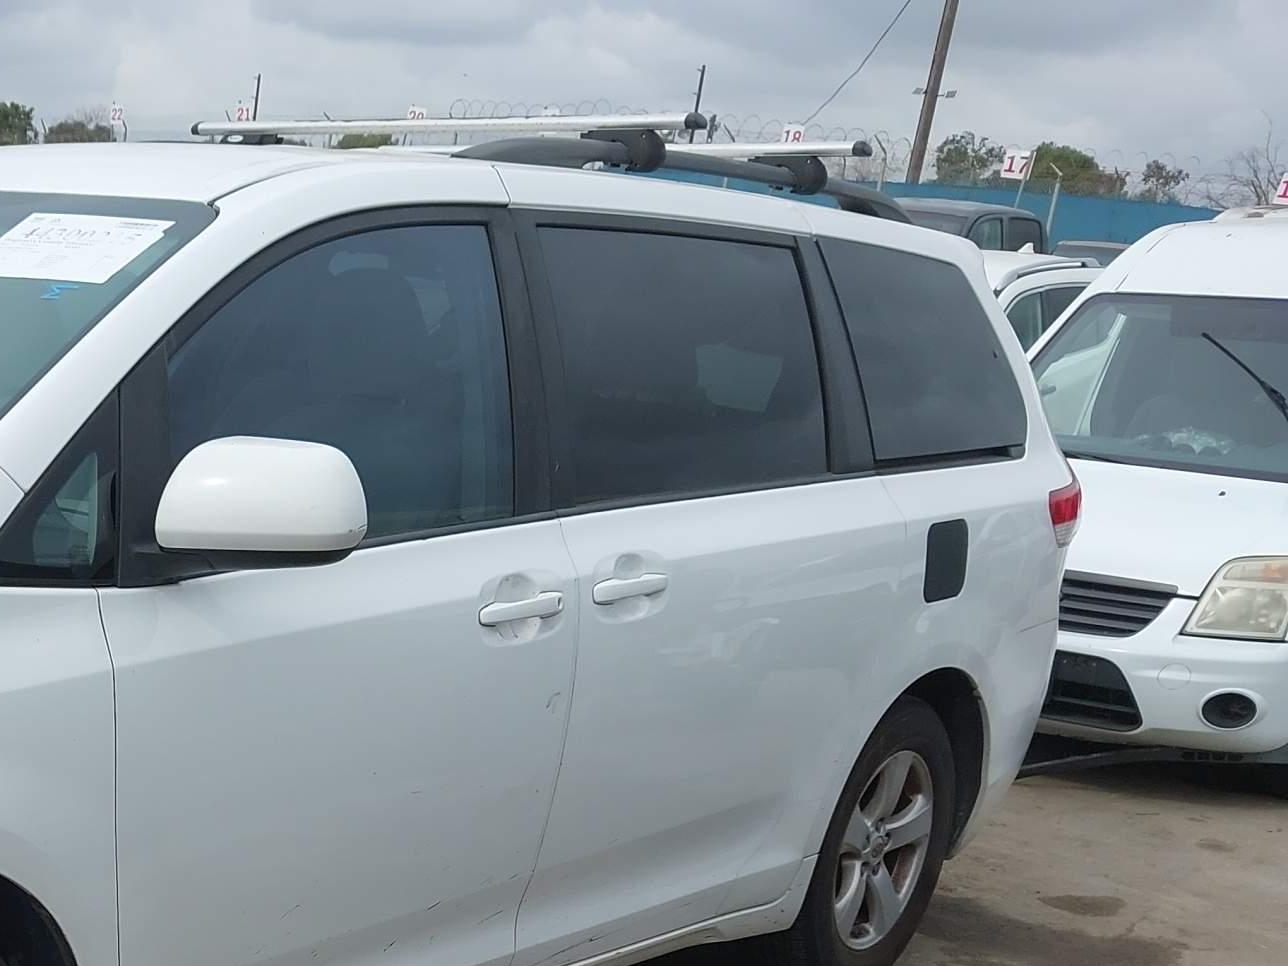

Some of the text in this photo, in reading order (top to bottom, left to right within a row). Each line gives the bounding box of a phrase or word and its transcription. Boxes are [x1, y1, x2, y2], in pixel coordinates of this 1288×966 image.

[111, 108, 123, 121] 22
[237, 107, 250, 121] 21
[784, 129, 802, 143] 18
[1004, 155, 1031, 174] 17
